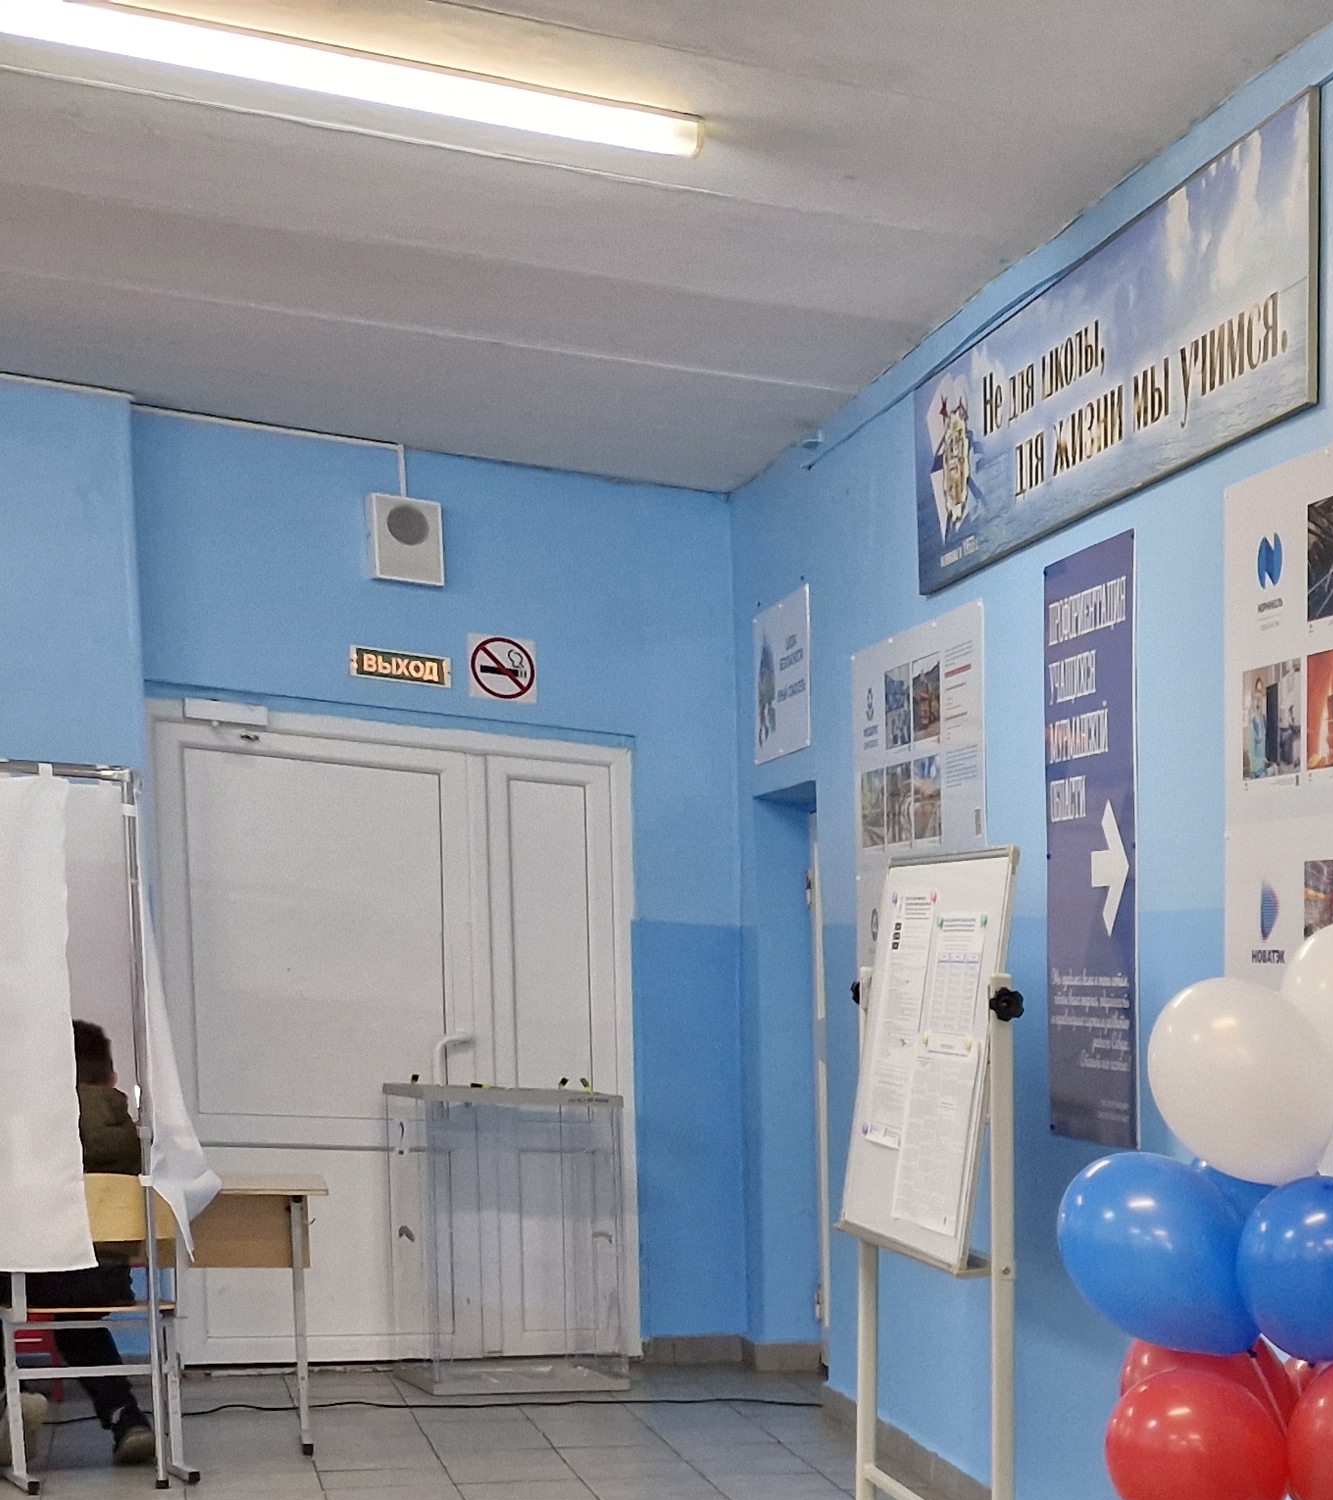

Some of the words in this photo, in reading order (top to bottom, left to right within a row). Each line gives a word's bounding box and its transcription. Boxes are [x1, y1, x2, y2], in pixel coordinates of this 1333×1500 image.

[982, 371, 1002, 437] Не
[1008, 363, 1036, 422] для
[1041, 319, 1106, 401] школы,
[1014, 432, 1045, 497] для
[1052, 384, 1124, 478] жизни
[1132, 358, 1170, 434] мы
[1180, 291, 1288, 429] учимся.
[363, 654, 438, 682] ВЫХОД
[1251, 949, 1286, 964] НОВАТЭК
